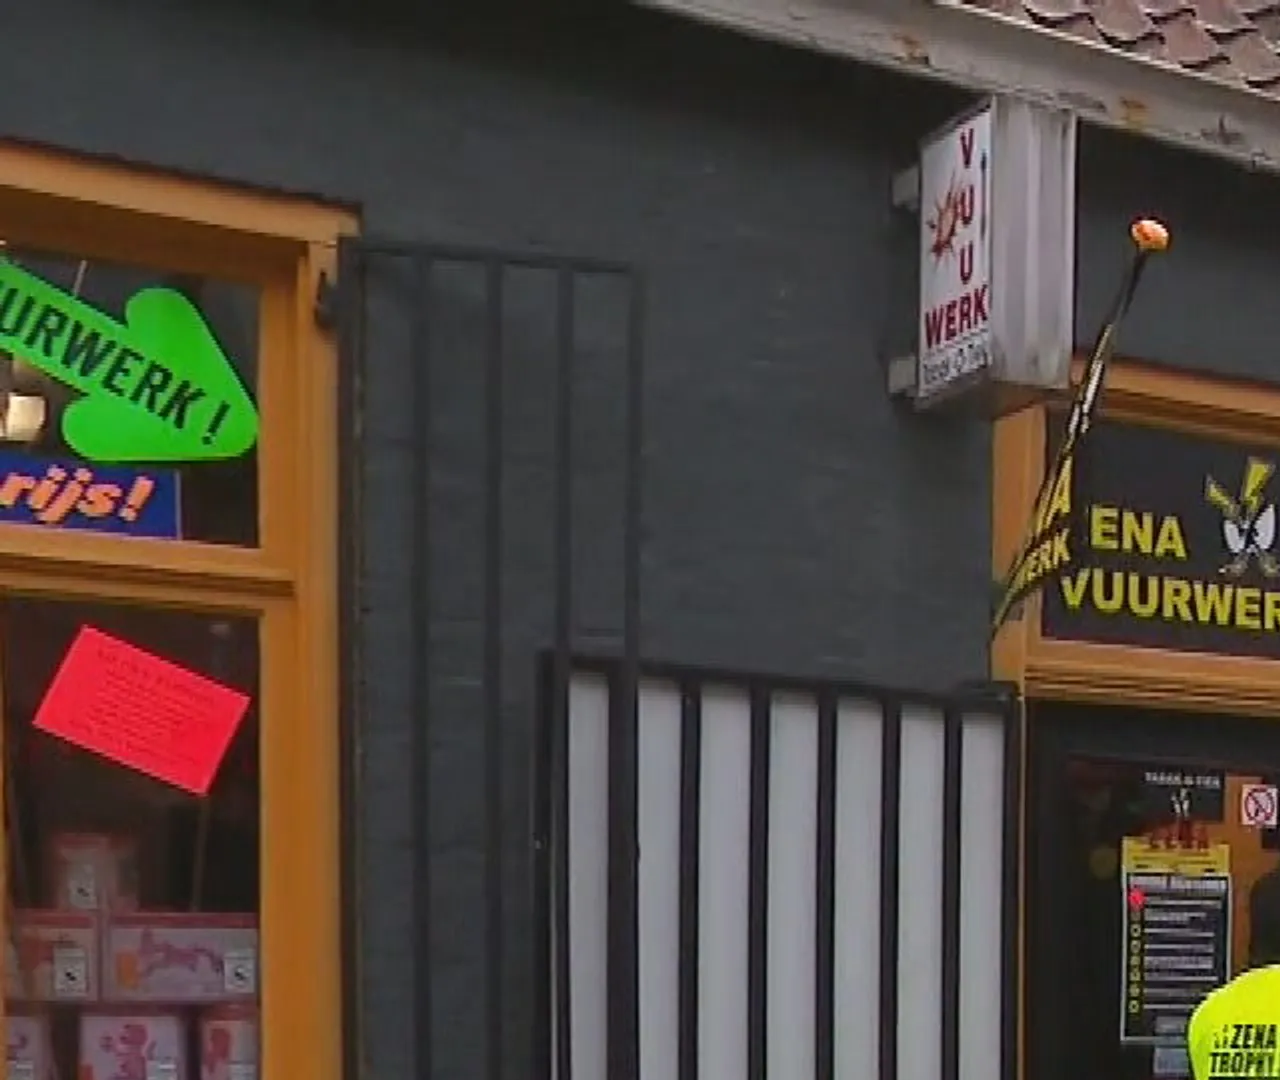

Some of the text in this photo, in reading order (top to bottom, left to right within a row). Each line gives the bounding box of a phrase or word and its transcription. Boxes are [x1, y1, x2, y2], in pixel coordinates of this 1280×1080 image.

[925, 285, 988, 349] WERK
[0, 280, 231, 445] URWERK!
[1089, 503, 1187, 560] ENA
[1208, 1051, 1277, 1074] TROPHY
[1230, 1023, 1278, 1050] ZENA
